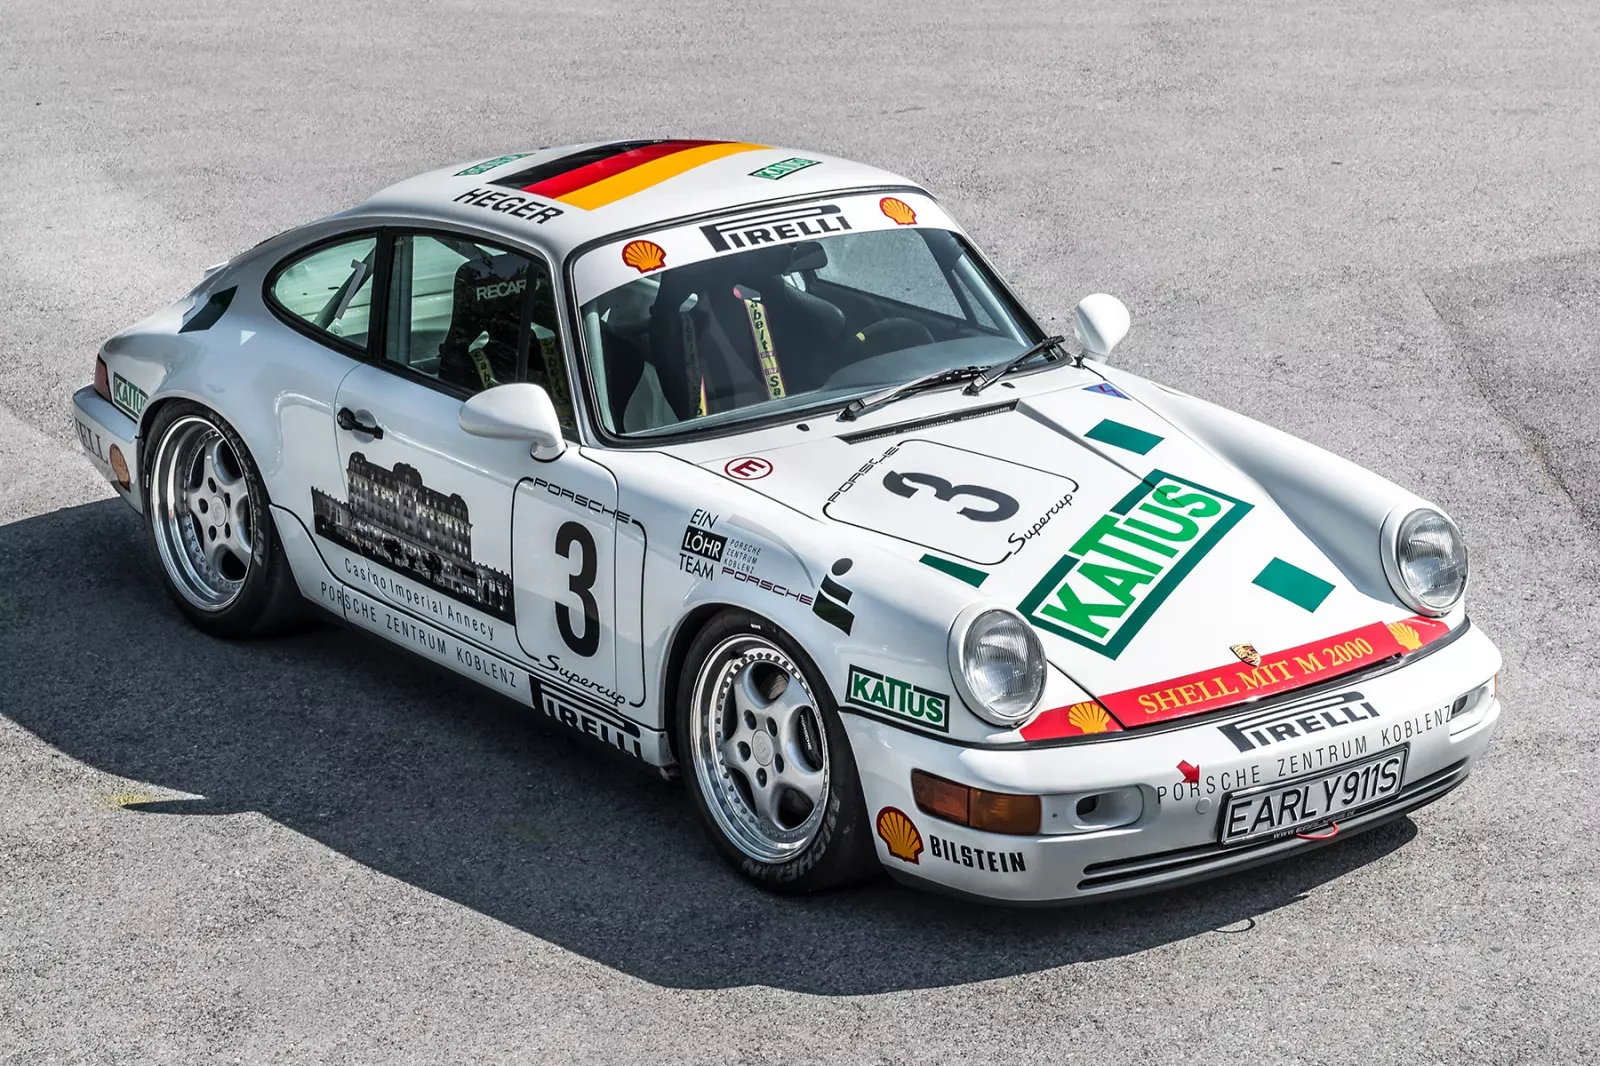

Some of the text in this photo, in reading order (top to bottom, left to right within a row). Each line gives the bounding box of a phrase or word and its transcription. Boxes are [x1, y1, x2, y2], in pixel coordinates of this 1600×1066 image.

[452, 188, 565, 225] HEGER
[699, 204, 852, 252] PIRELLI
[476, 278, 541, 300] RECAR
[731, 459, 766, 477] E
[827, 446, 900, 503] PORSCHE
[533, 477, 631, 524] PORSCHE
[690, 508, 719, 529] EIN
[882, 470, 1020, 523] 3
[684, 530, 722, 559] LÖHR
[729, 539, 762, 556] PORSCHE
[1008, 492, 1073, 555] Supercup
[679, 553, 714, 581] TEAM
[723, 559, 755, 575] KOBLENZ
[726, 548, 758, 565] ZENTRUM
[1040, 484, 1222, 639] KATTUS
[345, 557, 495, 641] Casino Imperial Annecy
[555, 521, 600, 657] 3
[721, 566, 814, 606] PORSCHE
[321, 581, 517, 688] PORSCHE ZENTRUM KOBLENZ
[538, 654, 627, 706] Supercup
[852, 674, 944, 723] KATTUS
[1138, 637, 1374, 714] SHELL MIT M 2000
[529, 674, 641, 758] PIRELLI
[1217, 691, 1380, 752] PIRELLI
[1157, 705, 1450, 804] PORSCHE ZENTRUM KOBLENZ
[1228, 757, 1400, 842] EARLY911S
[929, 834, 1026, 873] BILSTEIN
